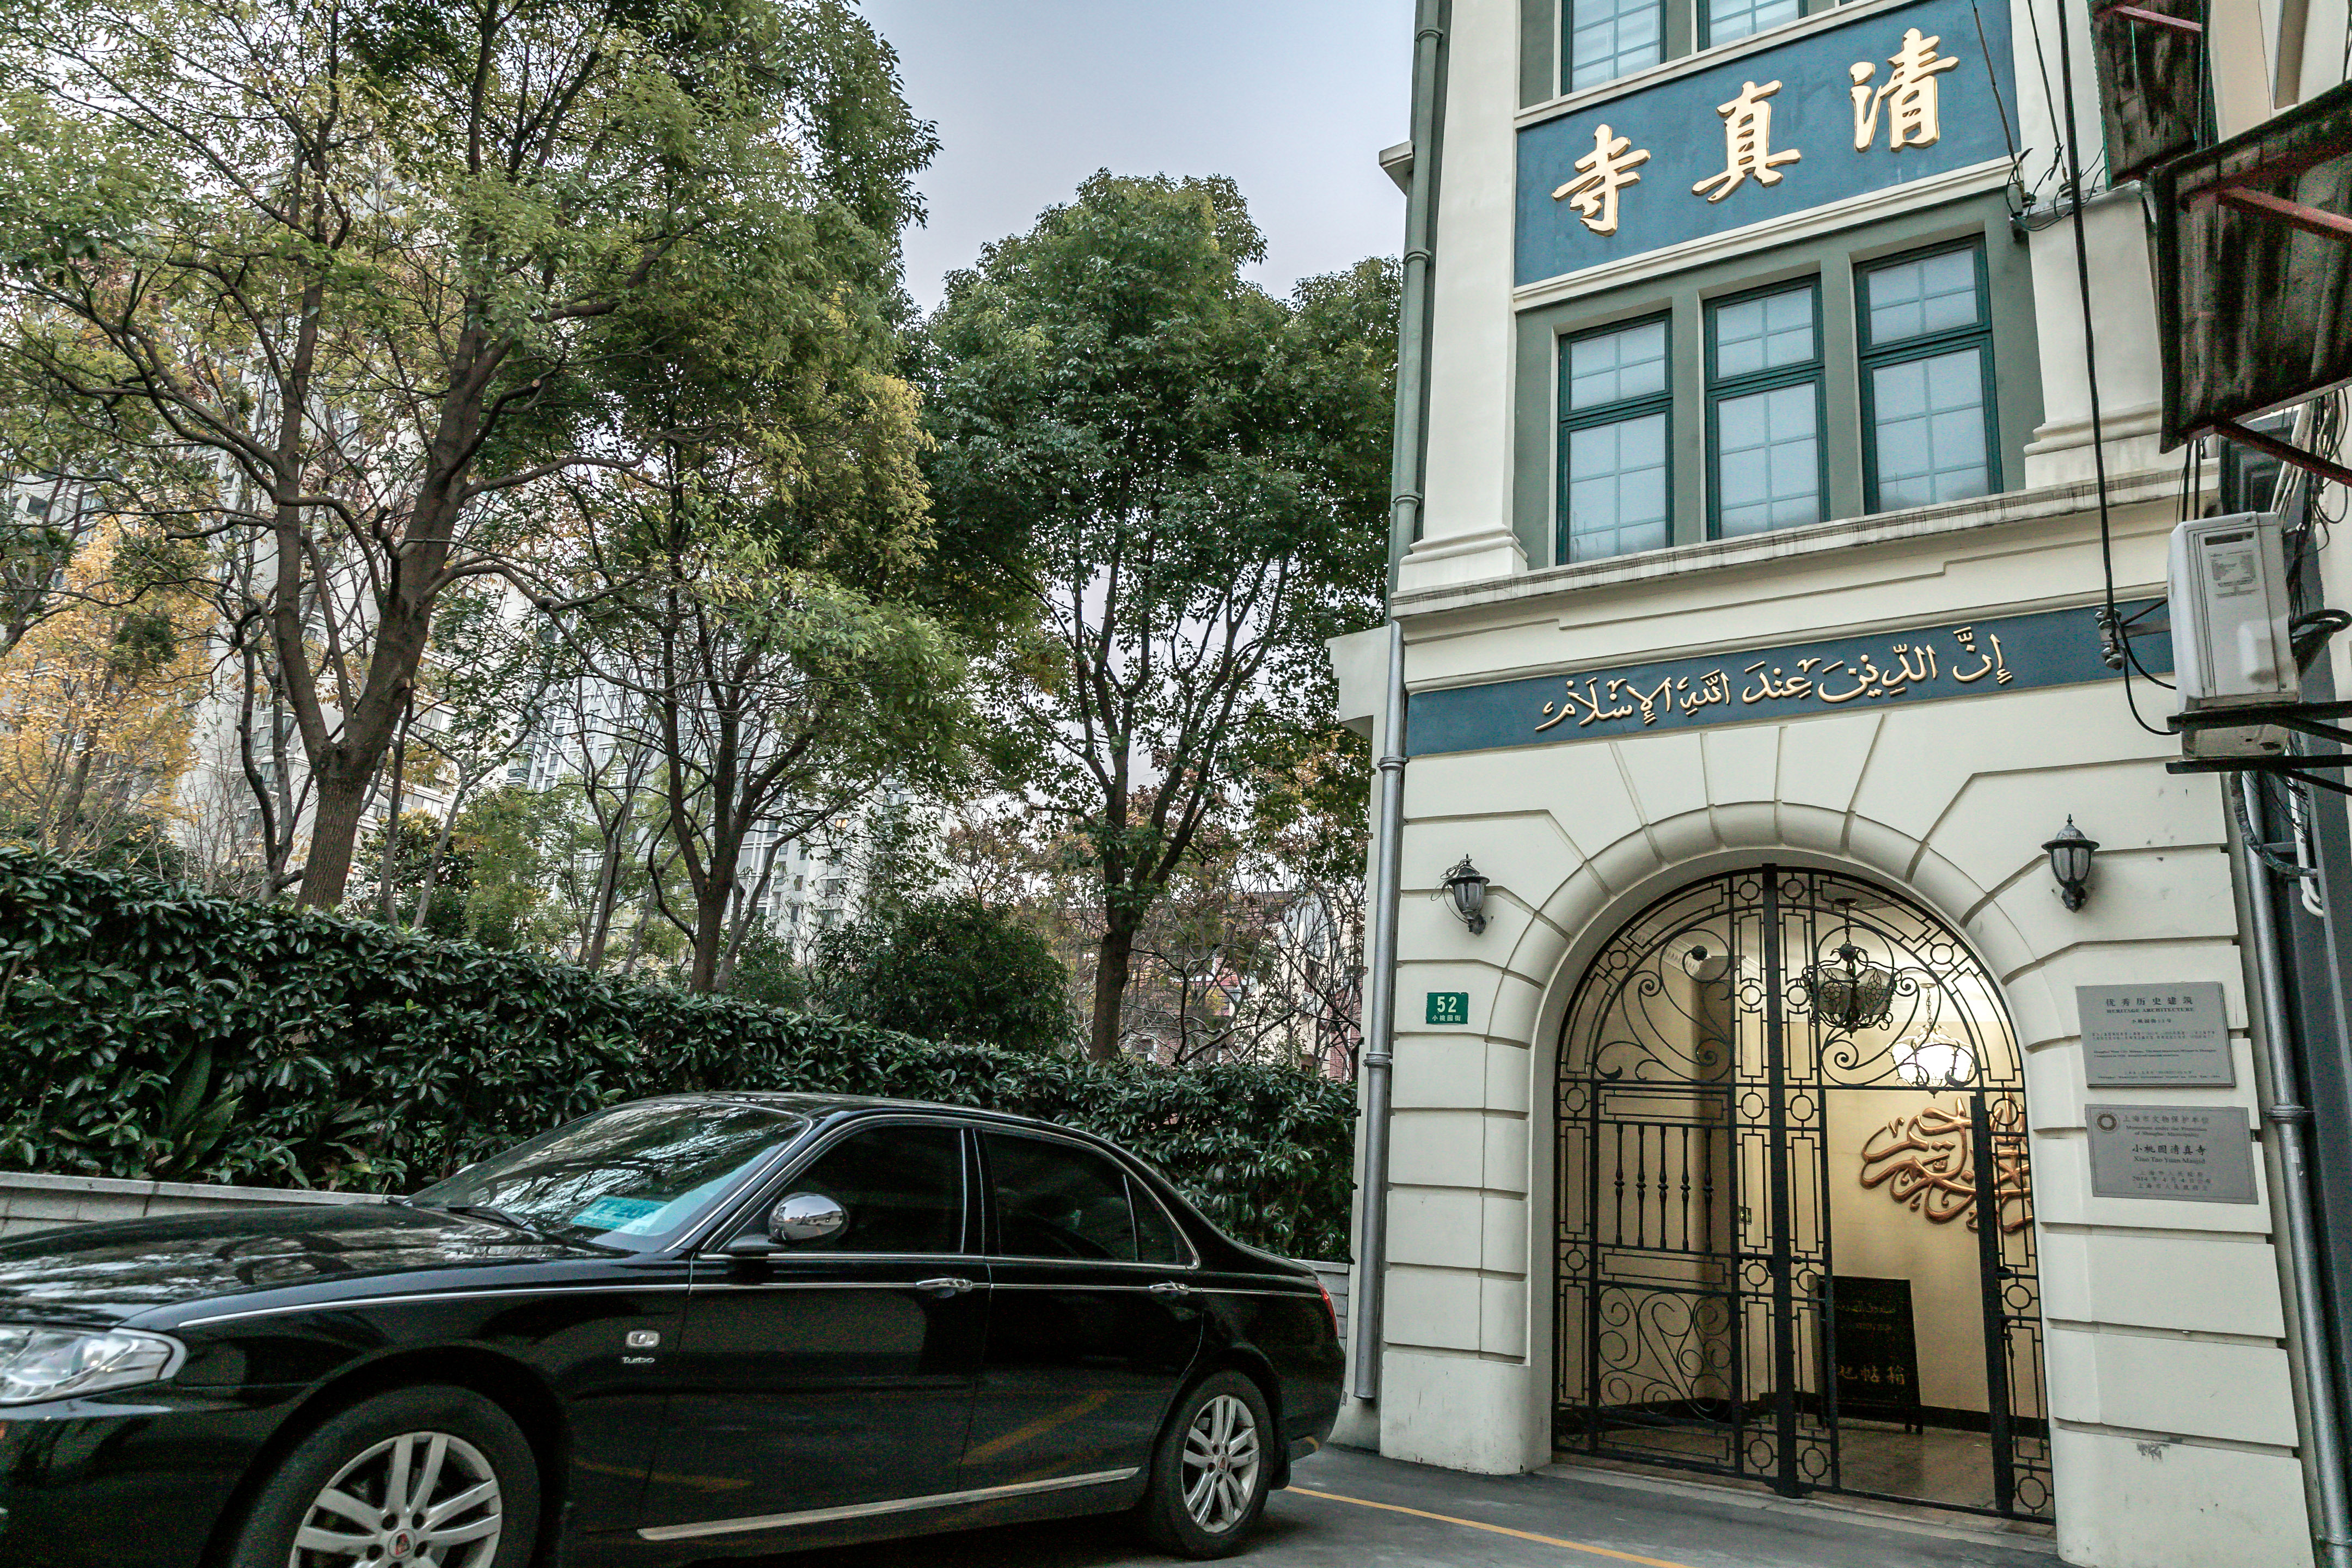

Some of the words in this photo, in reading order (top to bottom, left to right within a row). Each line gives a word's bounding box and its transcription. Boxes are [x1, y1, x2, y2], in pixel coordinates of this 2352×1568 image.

[1552, 28, 1959, 238] 清真寺
[1437, 996, 1457, 1013] 52
[2105, 996, 2194, 1007] 优秀历史建筑
[2123, 1115, 2209, 1124] 上海市文物保护单位
